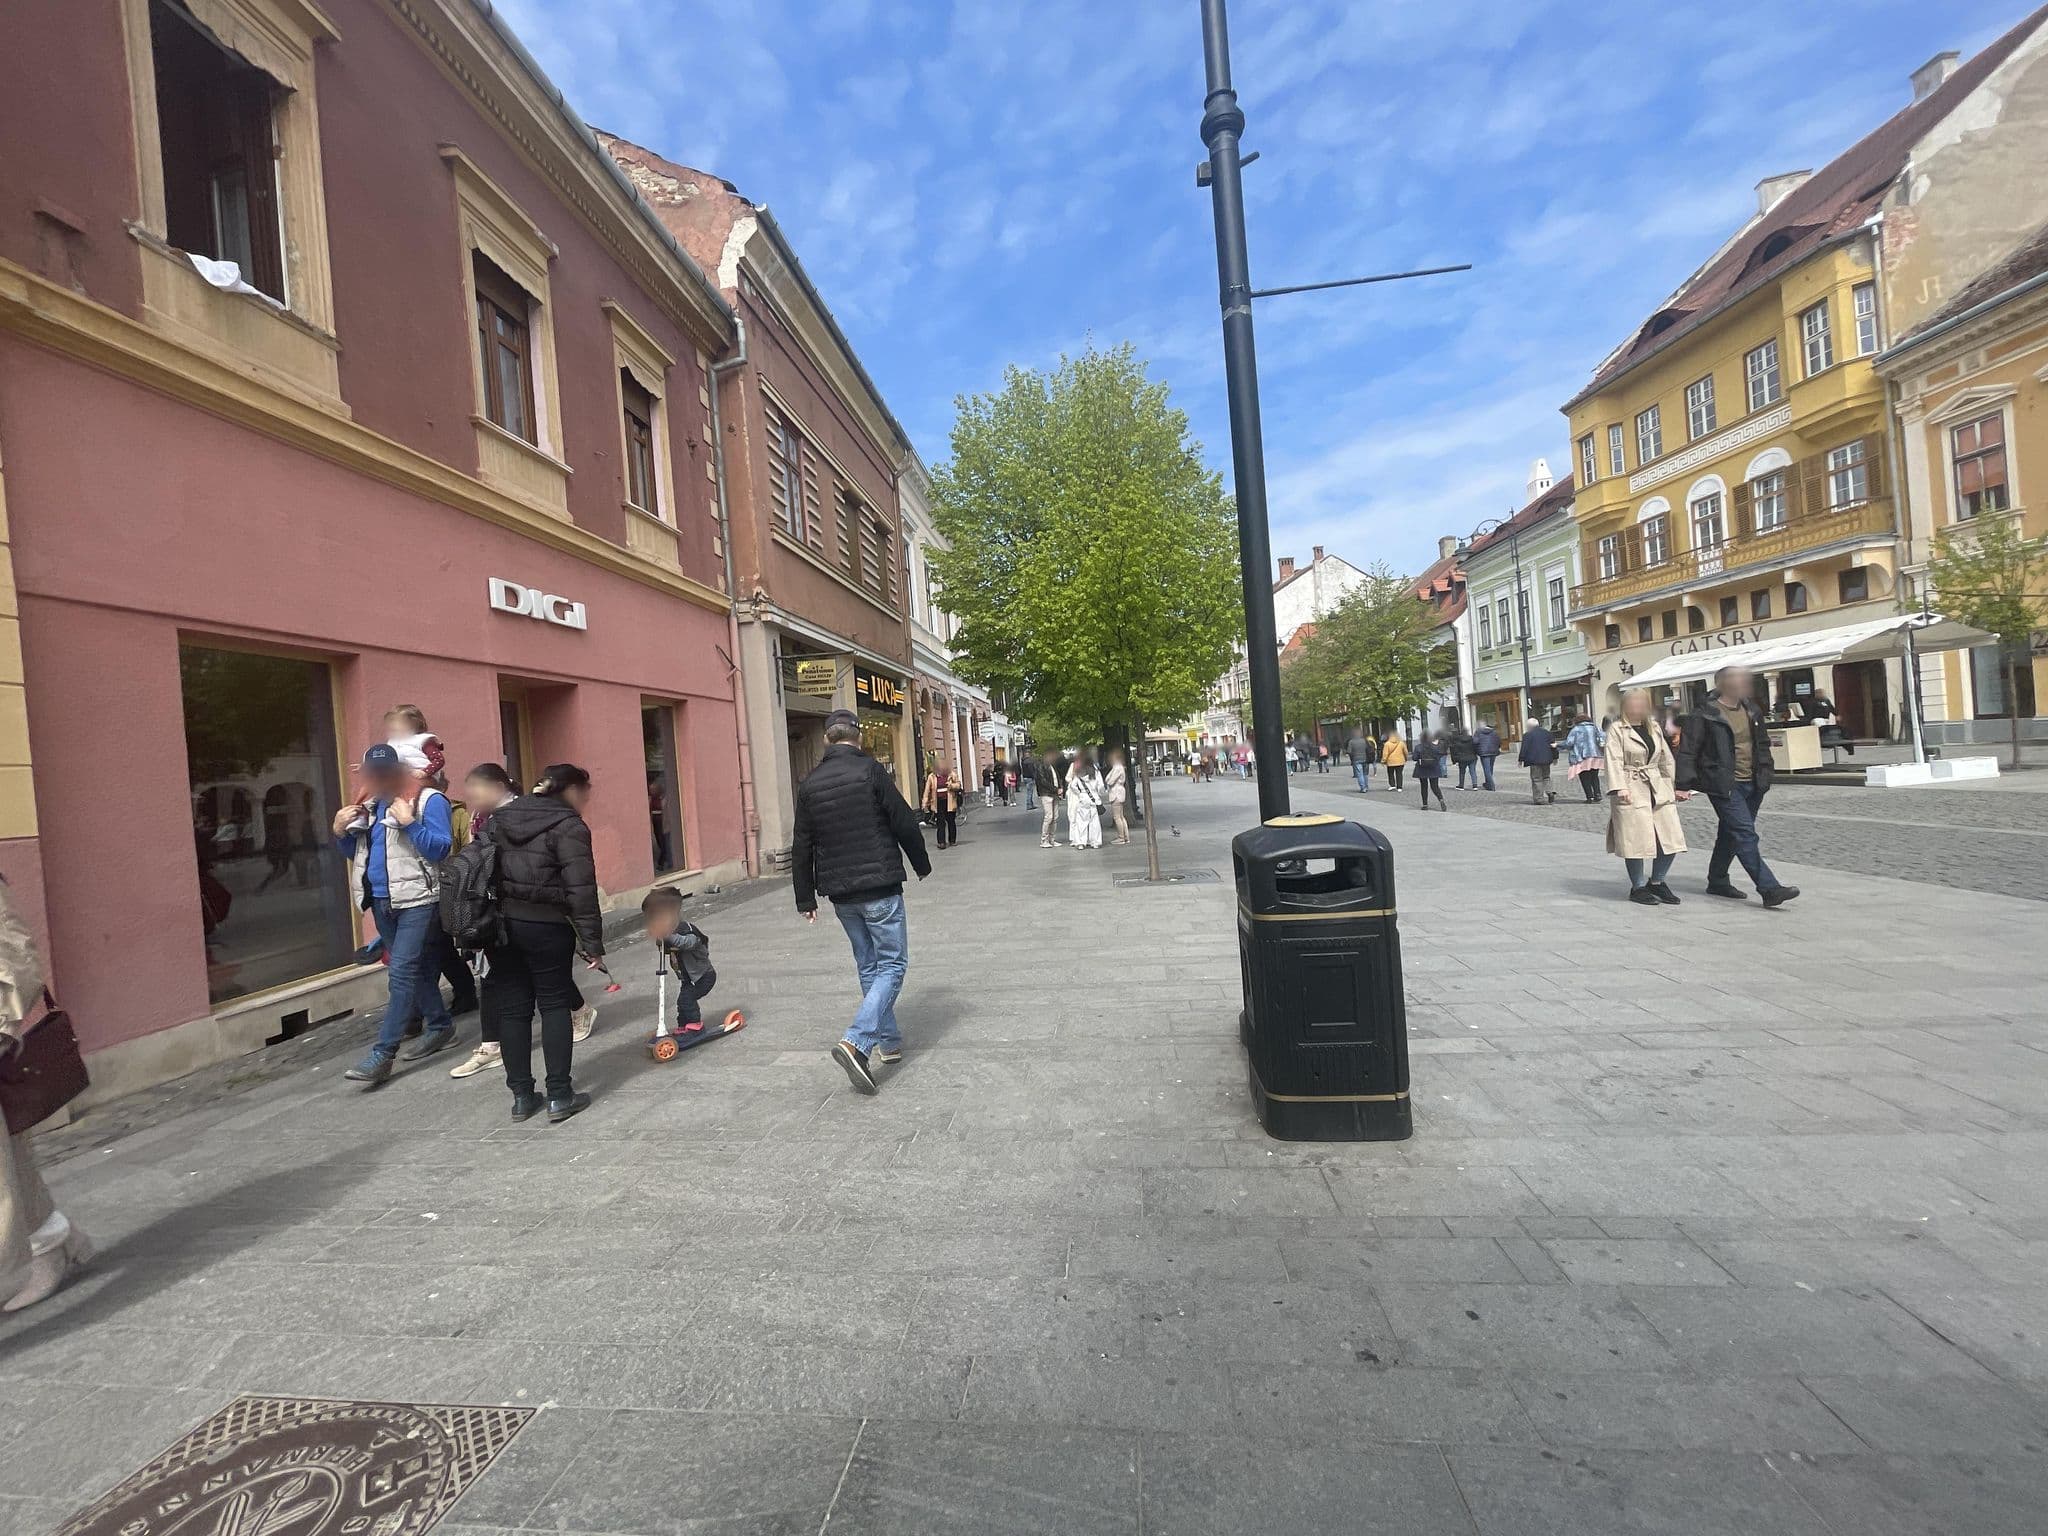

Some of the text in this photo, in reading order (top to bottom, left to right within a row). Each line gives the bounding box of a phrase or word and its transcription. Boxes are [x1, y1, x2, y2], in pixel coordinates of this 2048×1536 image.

[488, 577, 587, 630] DIGI
[1670, 626, 1764, 656] GATSBY
[871, 675, 897, 706] LUCA
